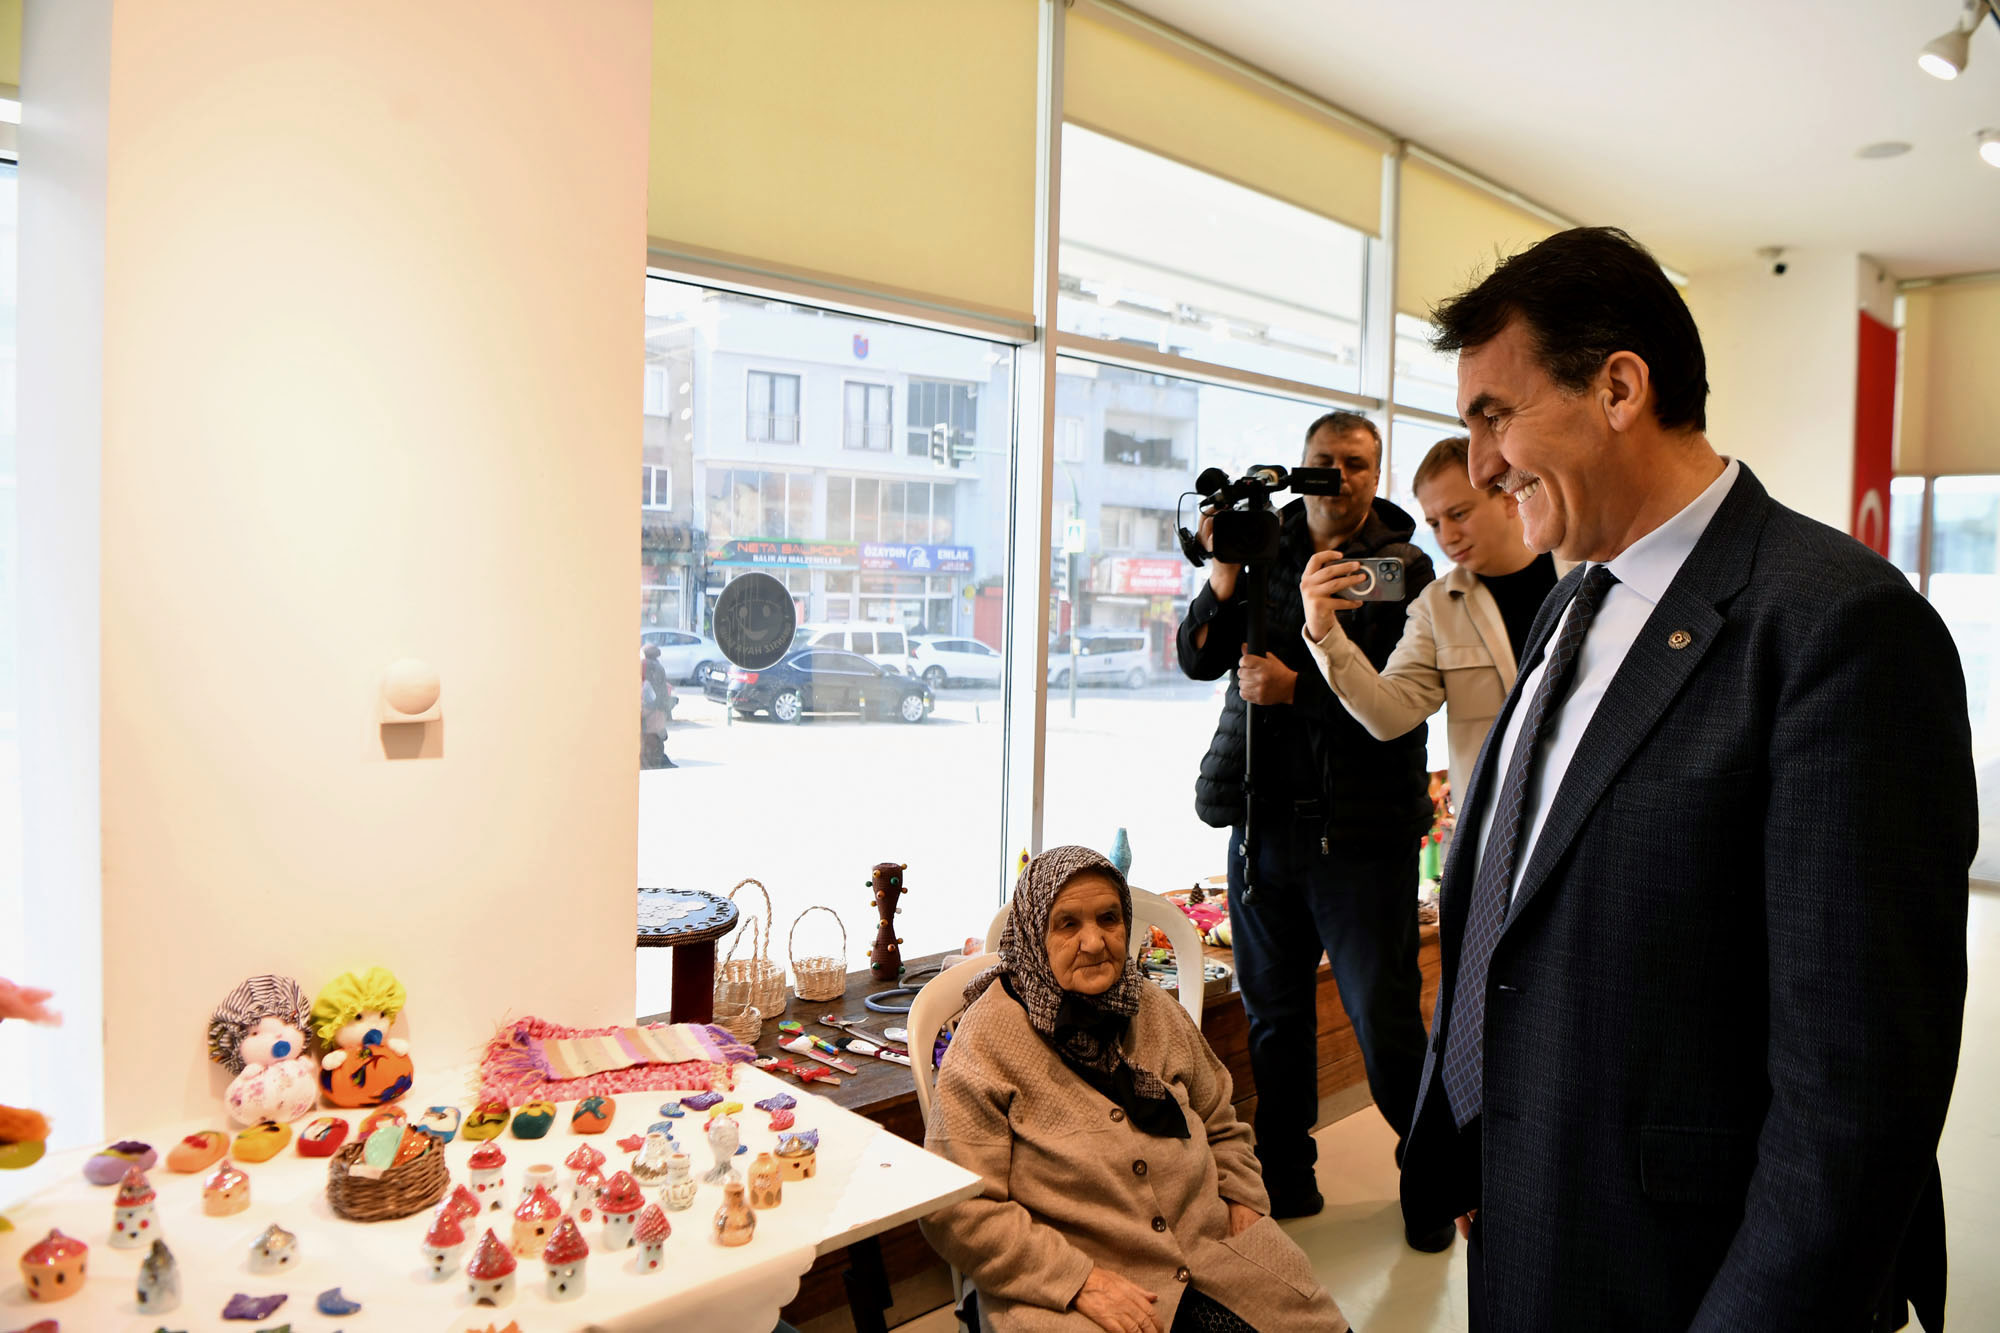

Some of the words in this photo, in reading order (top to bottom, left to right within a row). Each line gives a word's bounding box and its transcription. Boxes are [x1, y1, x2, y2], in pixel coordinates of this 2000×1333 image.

[737, 542, 777, 553] NETA
[864, 545, 906, 558] ÖZAYDIN
[937, 549, 969, 561] EMLAK
[753, 554, 776, 562] BALIK
[777, 555, 788, 563] AV
